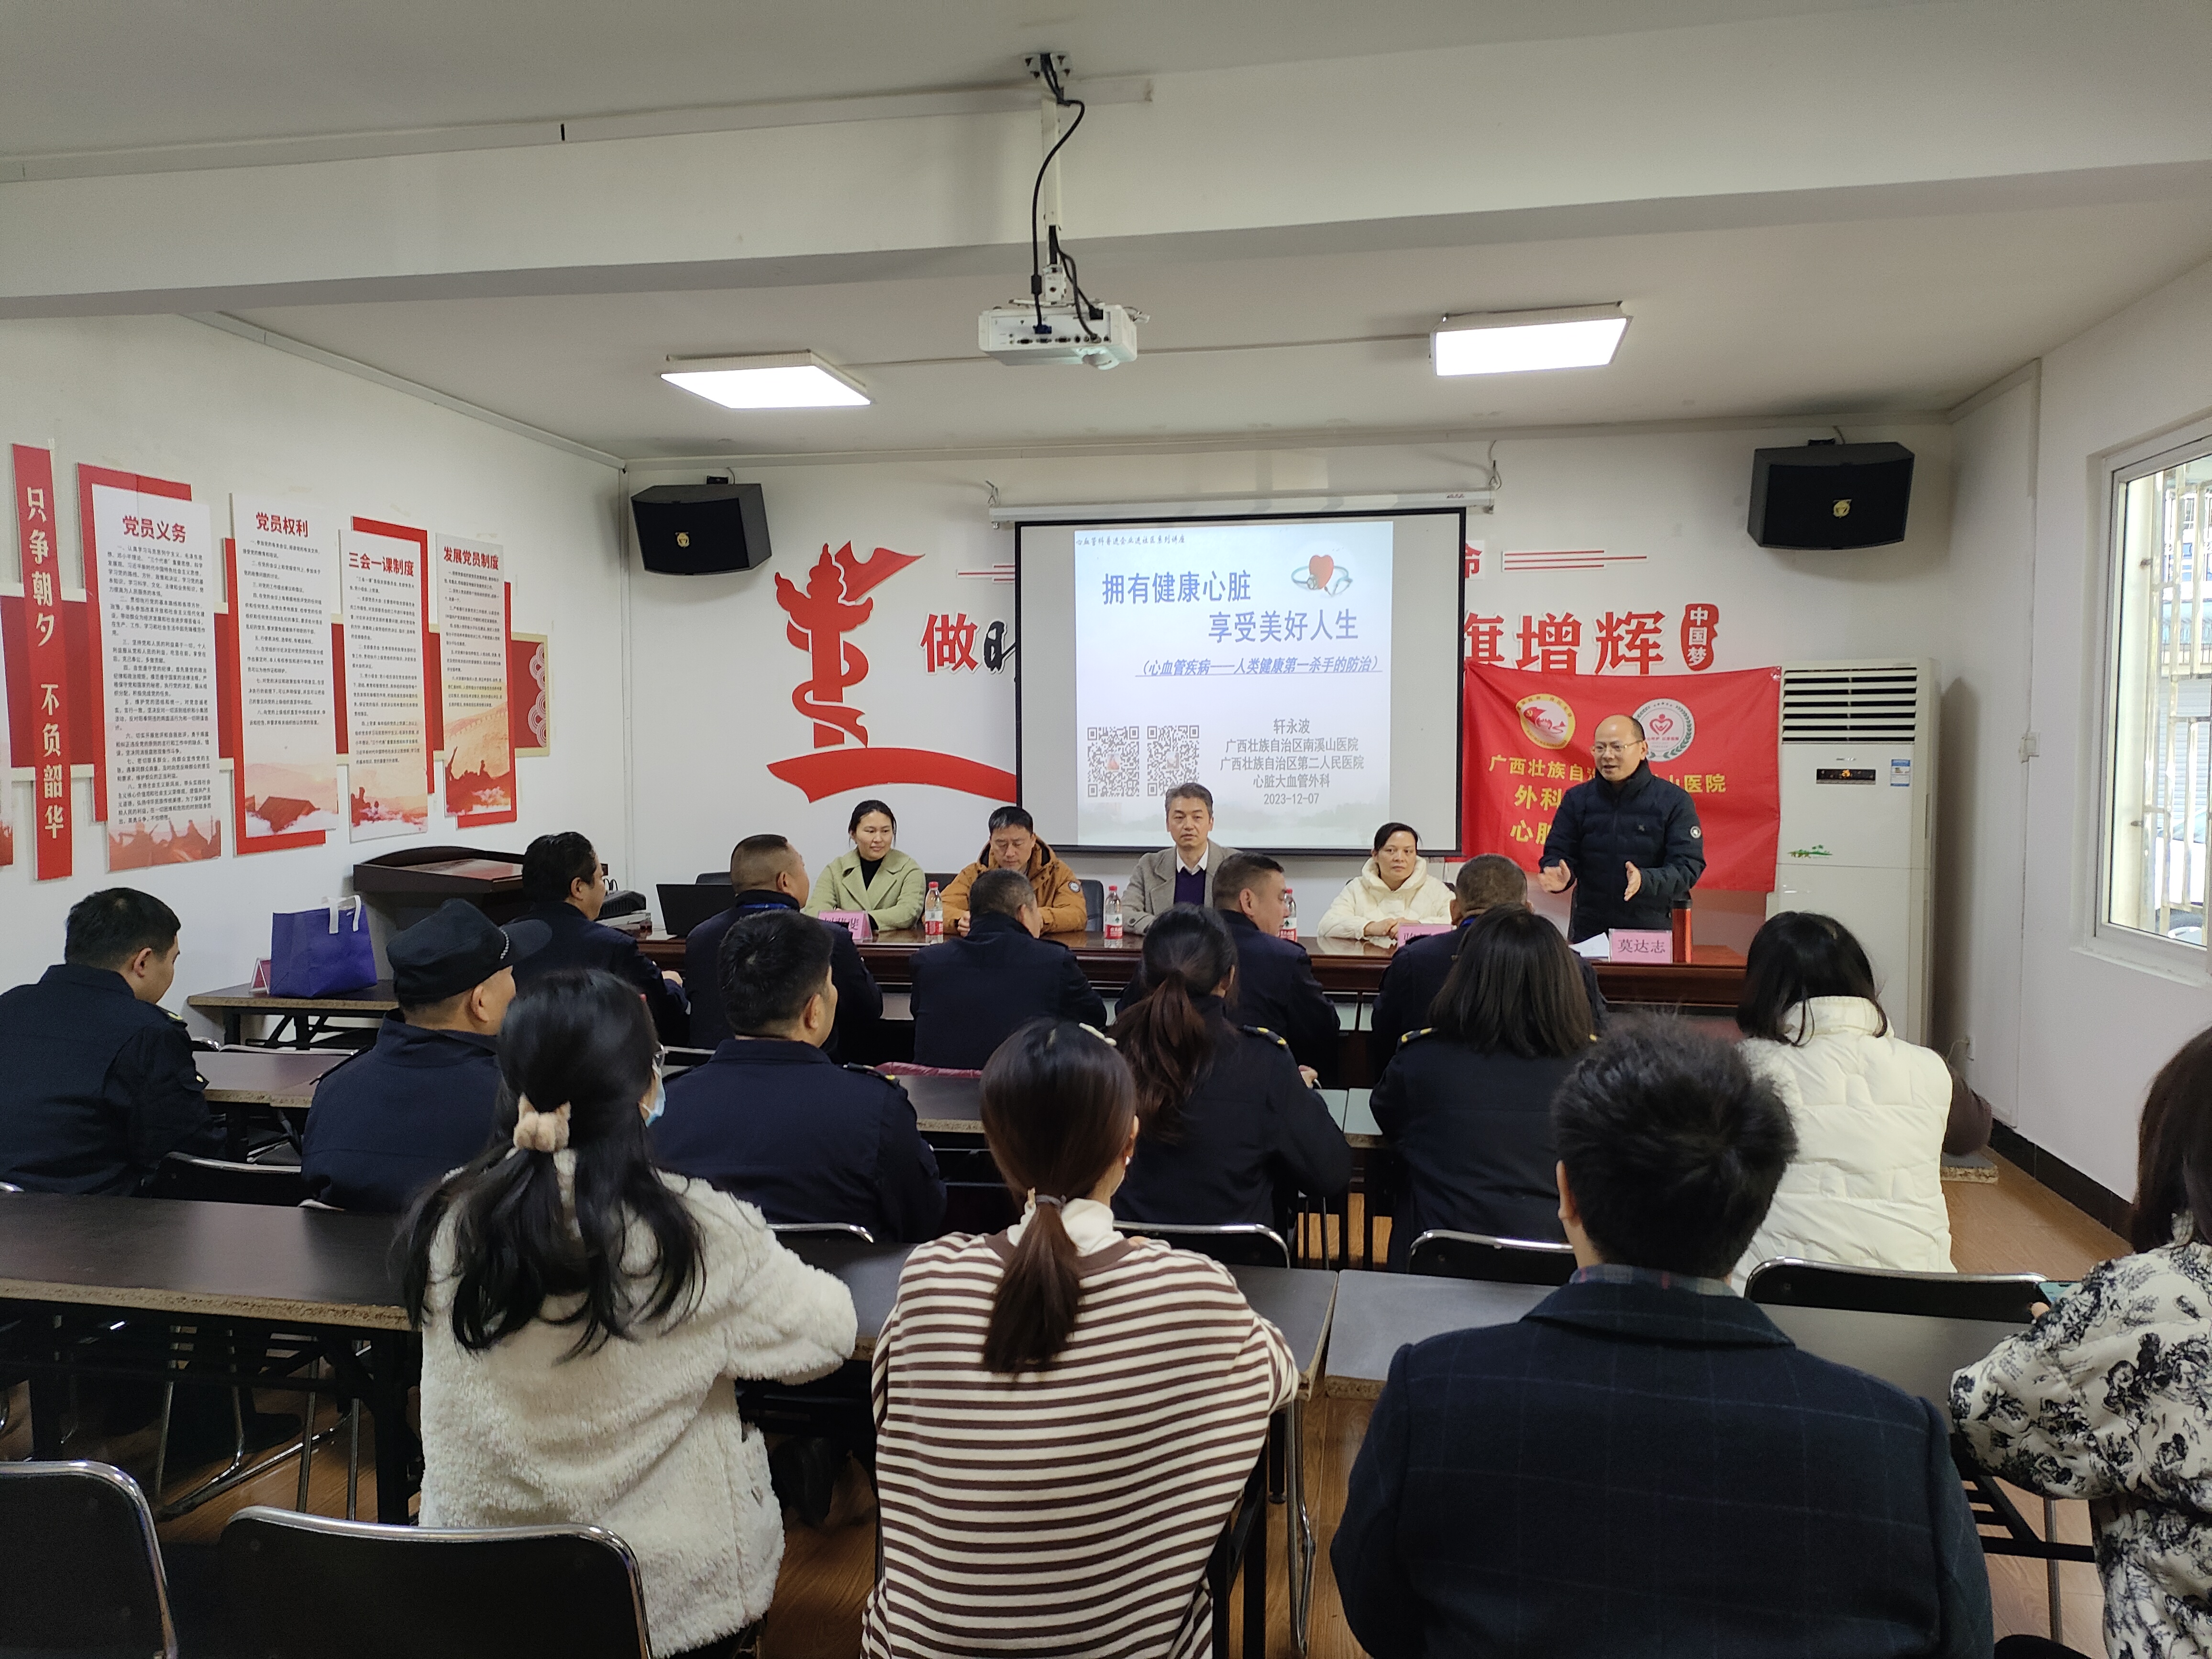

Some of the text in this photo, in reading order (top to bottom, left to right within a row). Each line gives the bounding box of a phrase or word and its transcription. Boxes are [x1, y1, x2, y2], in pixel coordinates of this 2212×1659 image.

[122, 515, 186, 543] 党员义务
[256, 511, 308, 538] 党员权利
[349, 552, 414, 577] 三会一课制度
[444, 545, 499, 570] 发展党员制度
[1102, 569, 1251, 605] 拥有健康心脏
[1208, 608, 1359, 643] 享受美好人生
[1687, 607, 1708, 666] 中国梦
[27, 487, 64, 839] 只争朝夕 不负韶华
[1273, 718, 1310, 734] 轩永波
[1226, 737, 1359, 753] 广西壮族自治区南溪山医院
[1220, 754, 1364, 771] 广西壮族自治区第二人民医院
[1253, 773, 1330, 788] 心脏大血管外科
[1263, 793, 1320, 805] 2023-12-07
[1617, 939, 1666, 953] 莫达志
